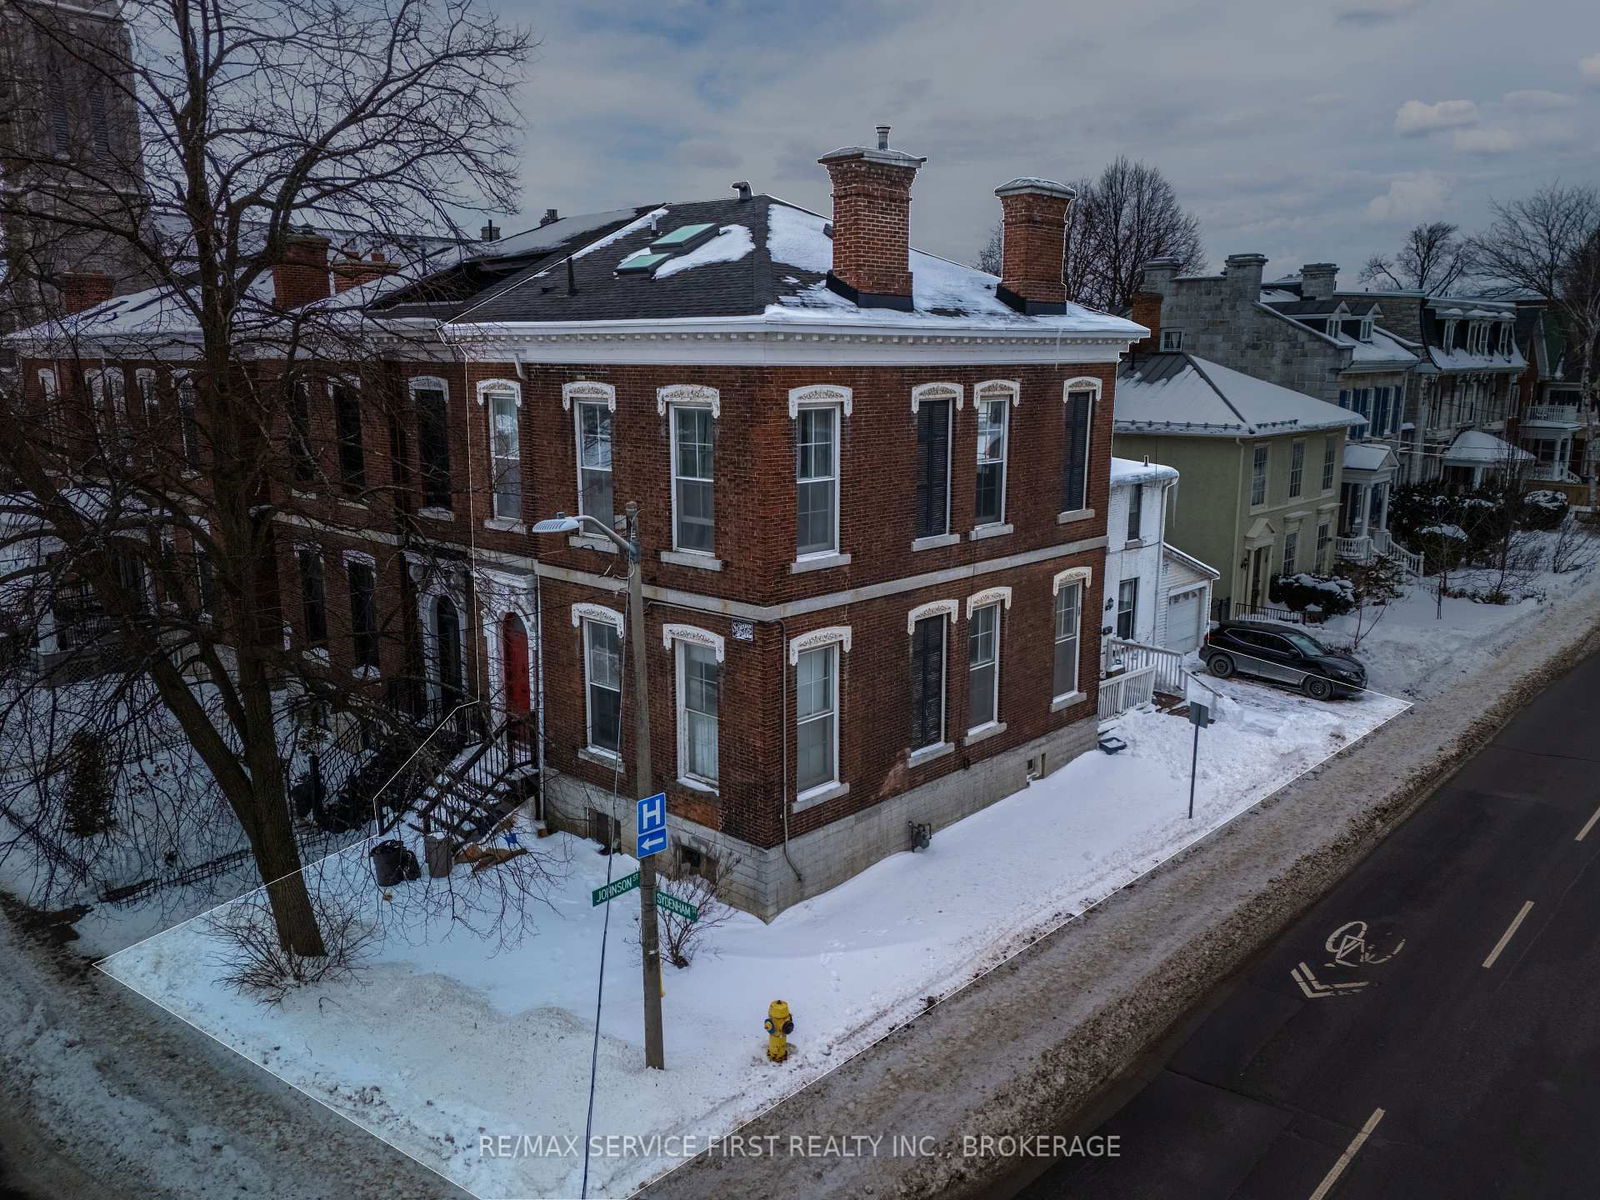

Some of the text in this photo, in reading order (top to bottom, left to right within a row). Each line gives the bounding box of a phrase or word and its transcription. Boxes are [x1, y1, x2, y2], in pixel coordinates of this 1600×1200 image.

[642, 798, 661, 830] H
[596, 877, 633, 903] JOHNSON
[656, 892, 691, 917] SYDENHAM
